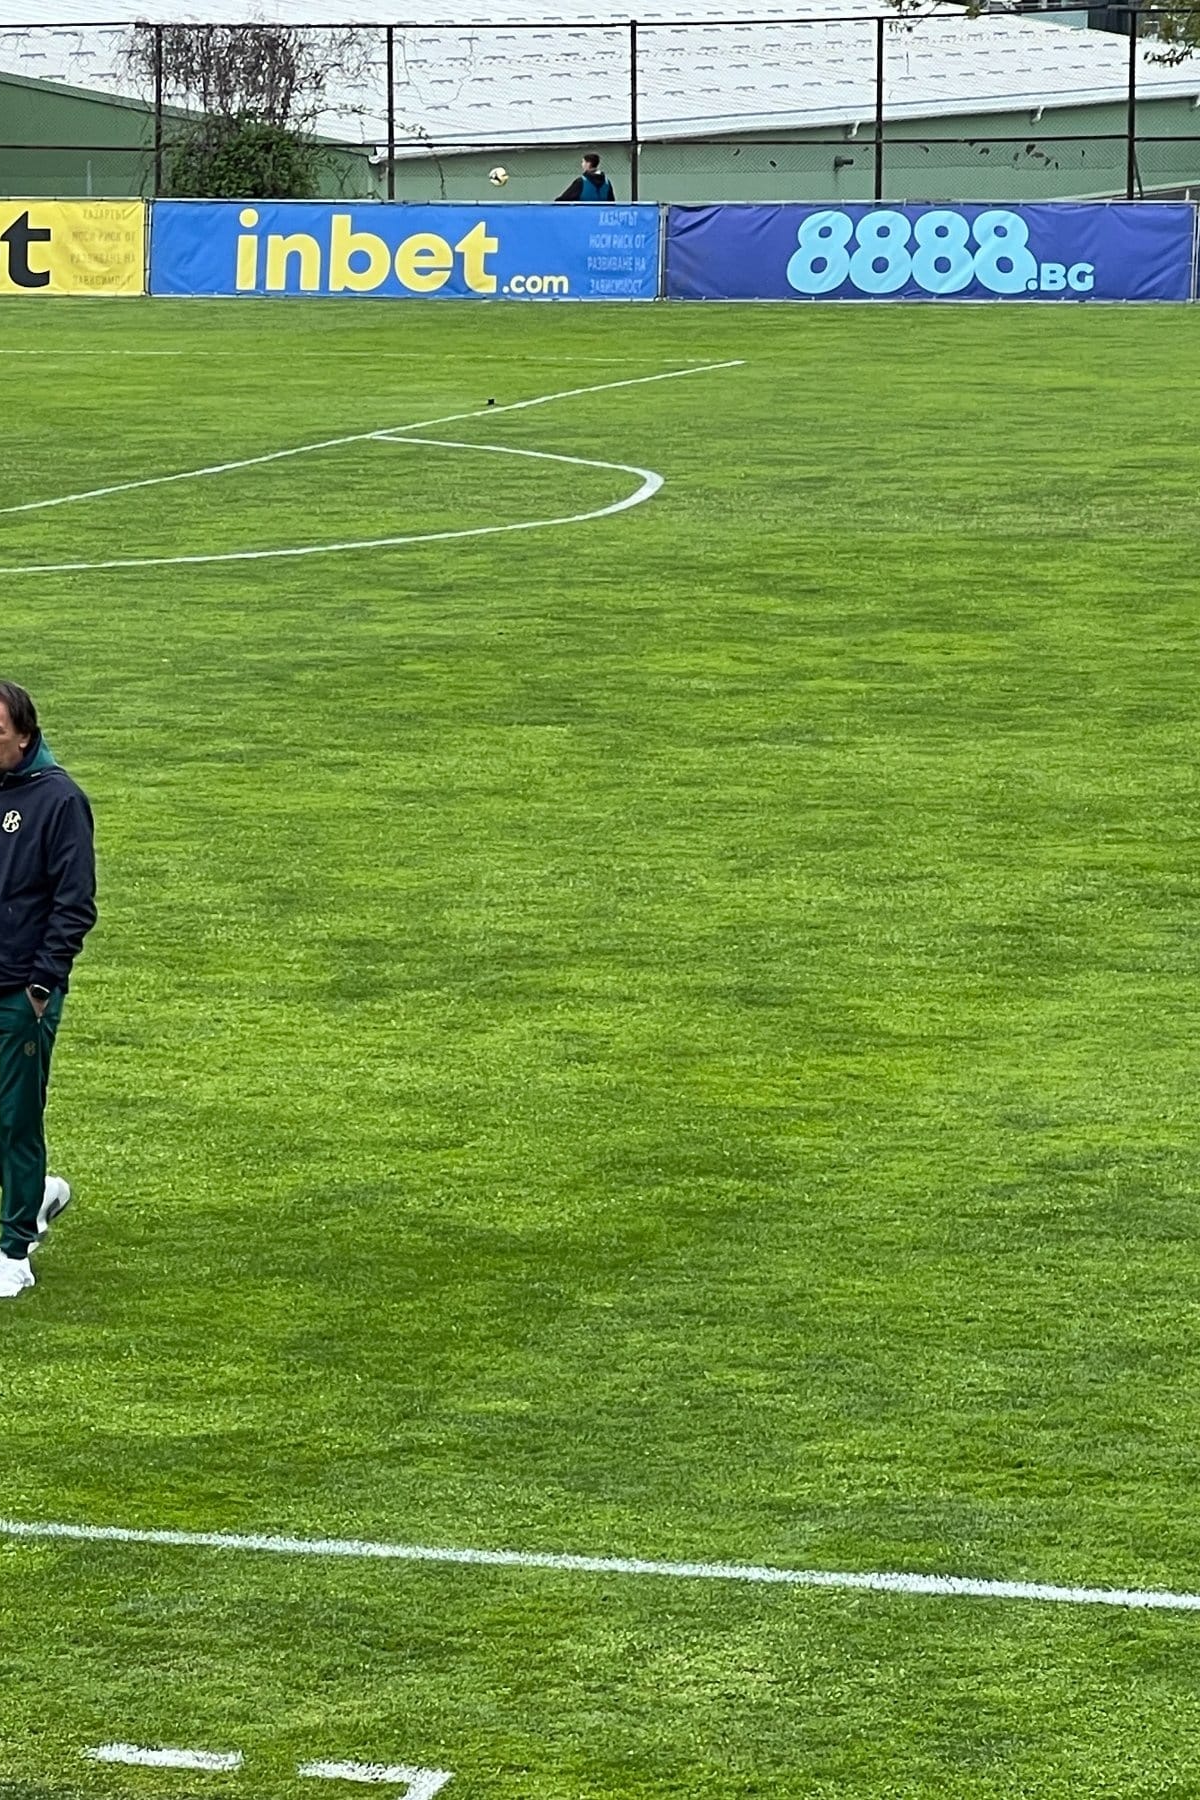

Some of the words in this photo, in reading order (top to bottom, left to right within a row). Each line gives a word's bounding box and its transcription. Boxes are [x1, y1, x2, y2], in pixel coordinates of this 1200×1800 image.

[635, 234, 646, 248] ОТ
[786, 209, 1095, 294] 8888.BG
[635, 256, 646, 271] НА
